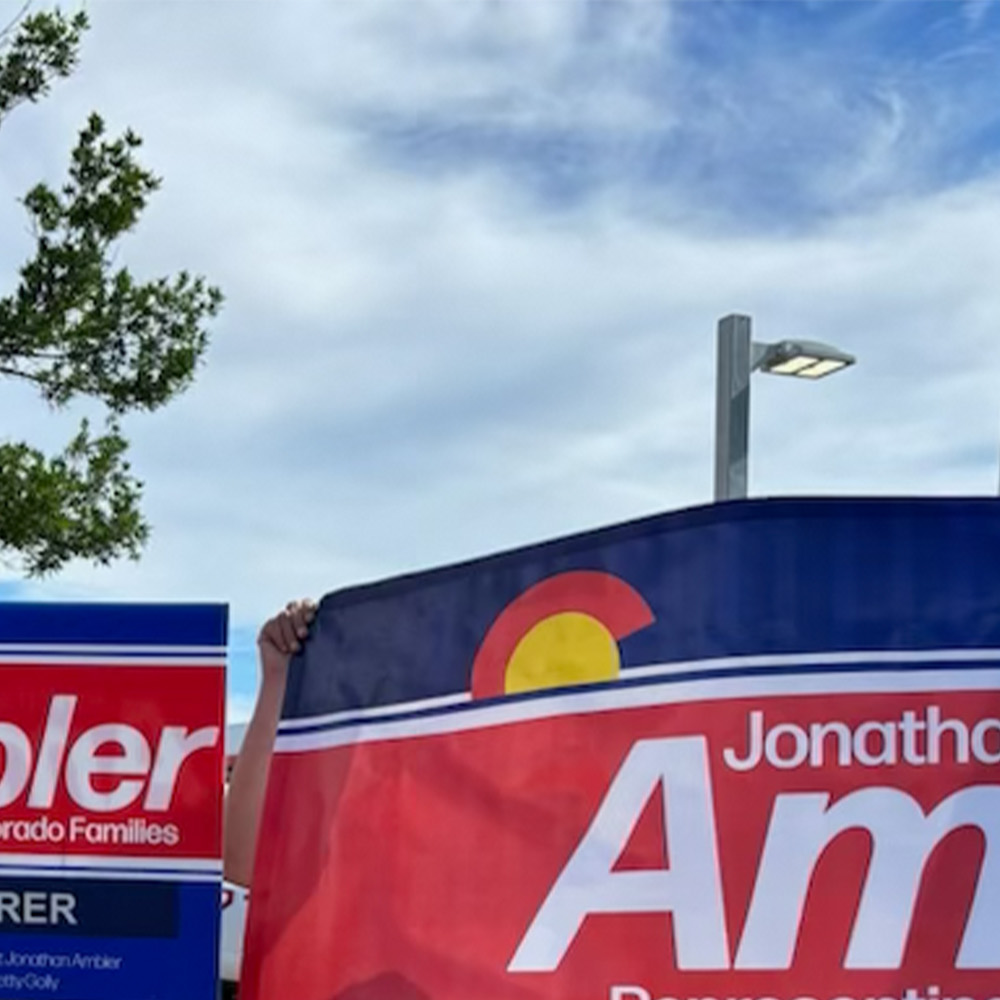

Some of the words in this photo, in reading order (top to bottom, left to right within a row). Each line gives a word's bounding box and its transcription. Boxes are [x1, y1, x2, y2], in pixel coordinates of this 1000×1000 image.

[69, 816, 179, 846] Families
[4, 950, 70, 968] Jonathan
[70, 952, 122, 970] Ambler
